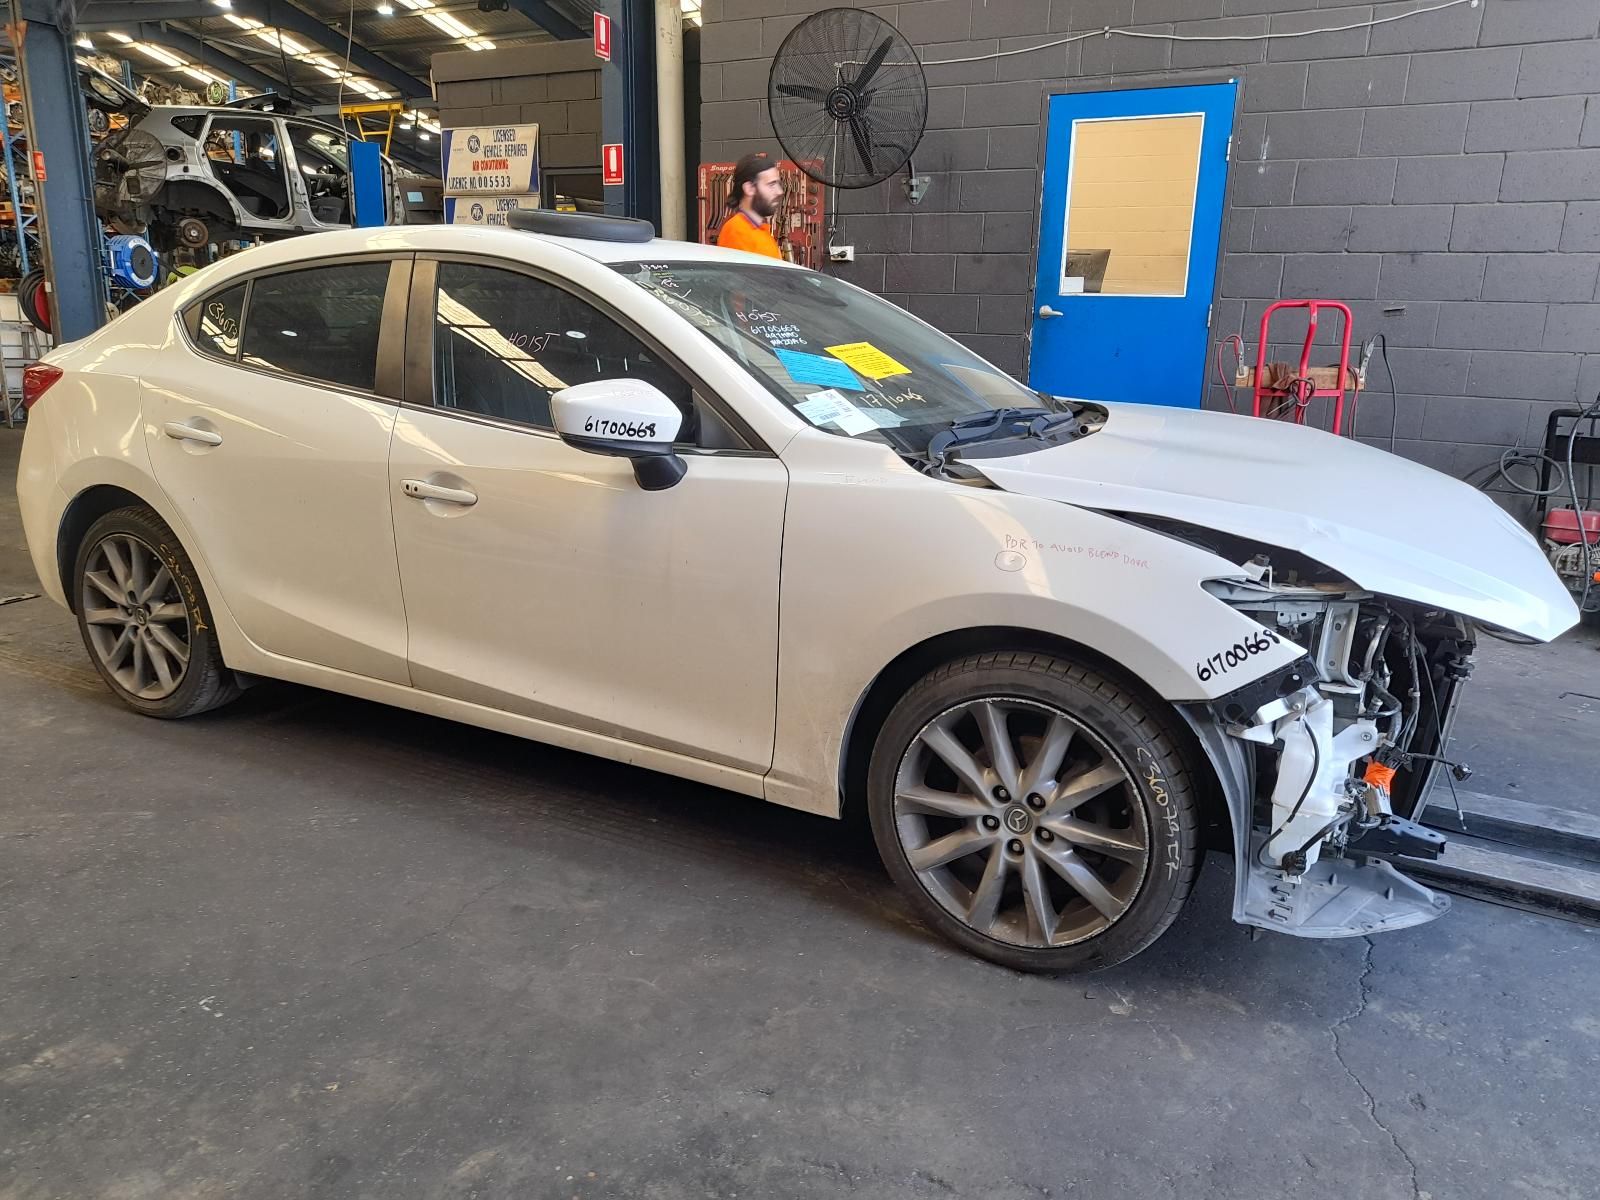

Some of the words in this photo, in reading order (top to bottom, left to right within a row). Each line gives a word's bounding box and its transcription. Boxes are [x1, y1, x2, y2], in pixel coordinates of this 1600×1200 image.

[493, 128, 516, 143] LICENSED
[483, 145, 503, 158] VEHICLE
[504, 144, 528, 157] REPAIRER
[448, 177, 468, 190] LICENCE
[478, 176, 511, 188] 005533
[506, 331, 561, 352] HOIST
[584, 416, 656, 438] 61700668
[1005, 534, 1028, 550] PDR
[1196, 629, 1281, 682] 61700668
